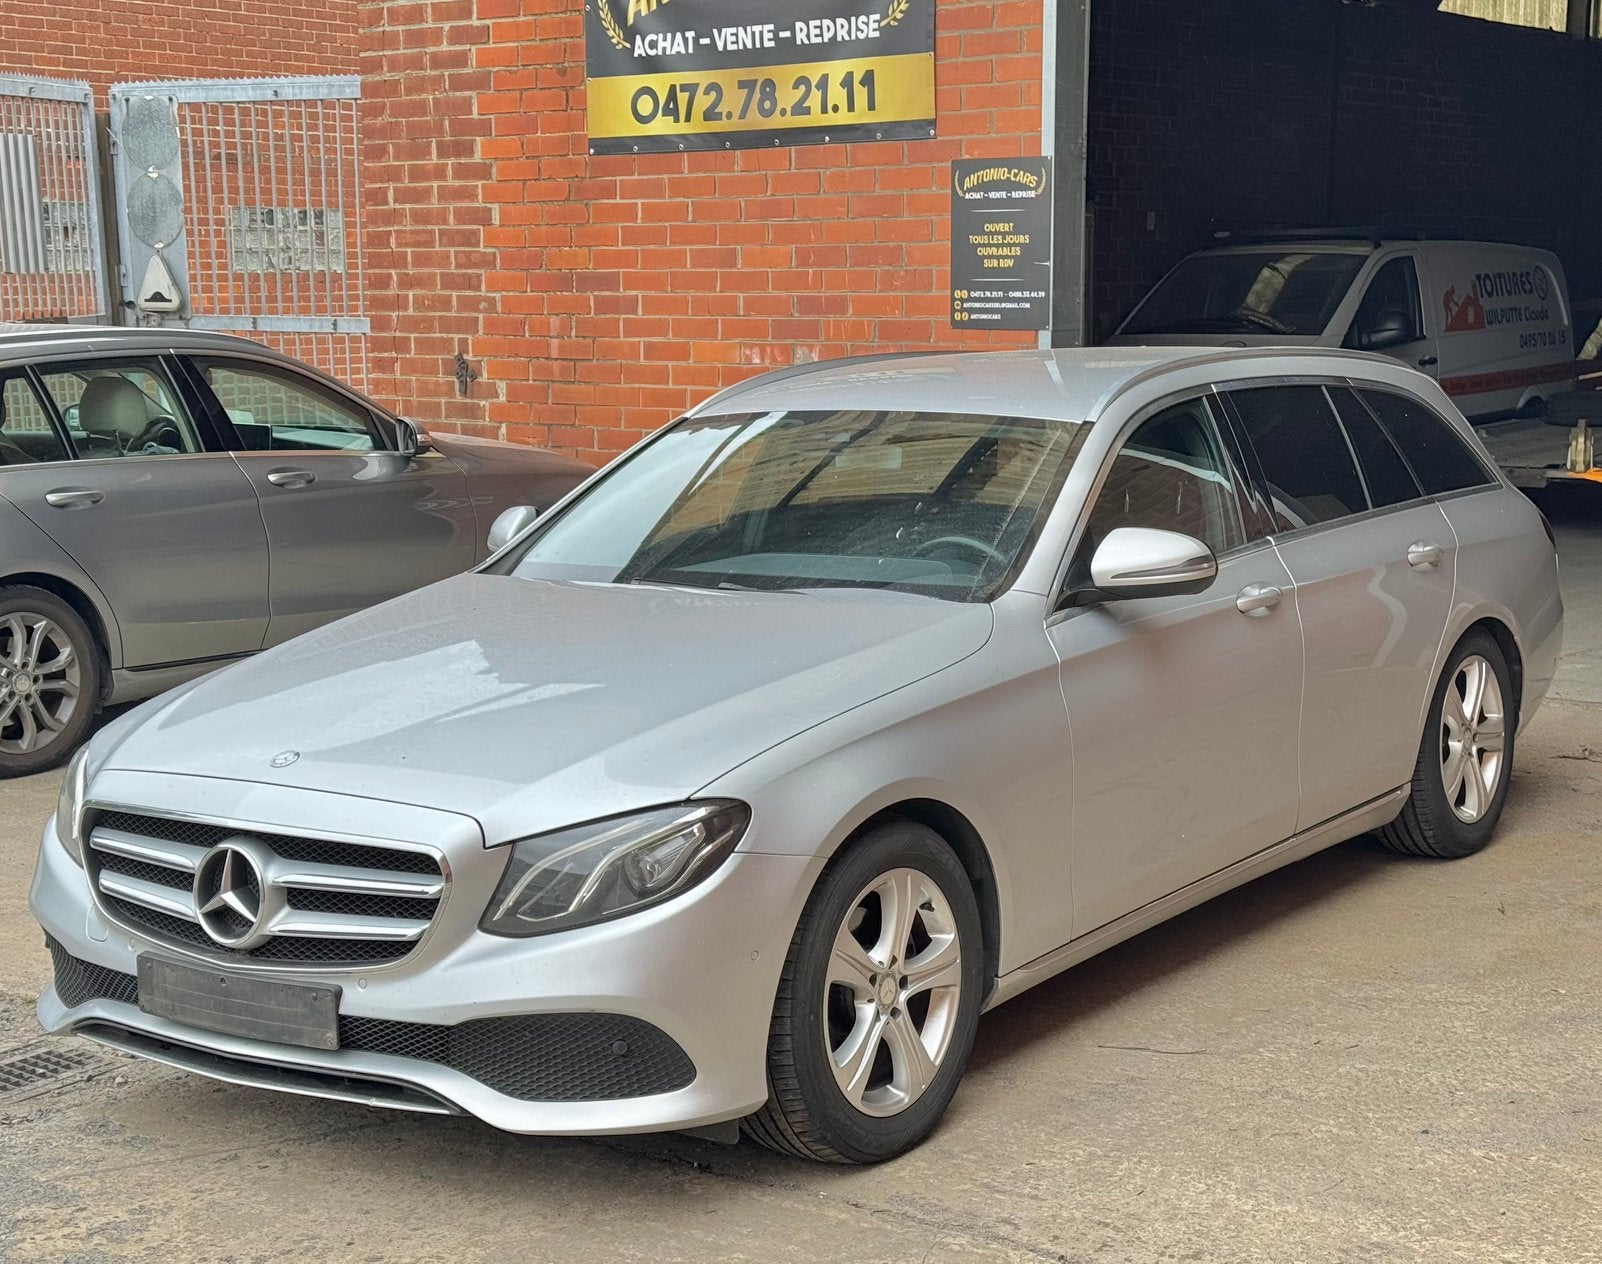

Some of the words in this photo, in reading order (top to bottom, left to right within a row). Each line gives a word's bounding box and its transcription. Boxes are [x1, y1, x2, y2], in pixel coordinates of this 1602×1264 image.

[633, 31, 696, 57] ACHAT
[713, 24, 775, 51] VENTE
[795, 14, 881, 45] REPRISE
[631, 69, 876, 125] 0472.78.21.11
[964, 167, 1038, 191] ANTONIO-CARS
[1012, 190, 1036, 198] REPRISE
[984, 223, 1014, 232] OUVERT
[969, 235, 988, 244] TOUS
[990, 235, 1002, 244] LES
[1004, 235, 1030, 243] JOURS
[977, 247, 1021, 256] OUVRABLES
[984, 259, 998, 267] SUR
[1000, 259, 1014, 267] RDV
[1475, 271, 1534, 299] TOITURES
